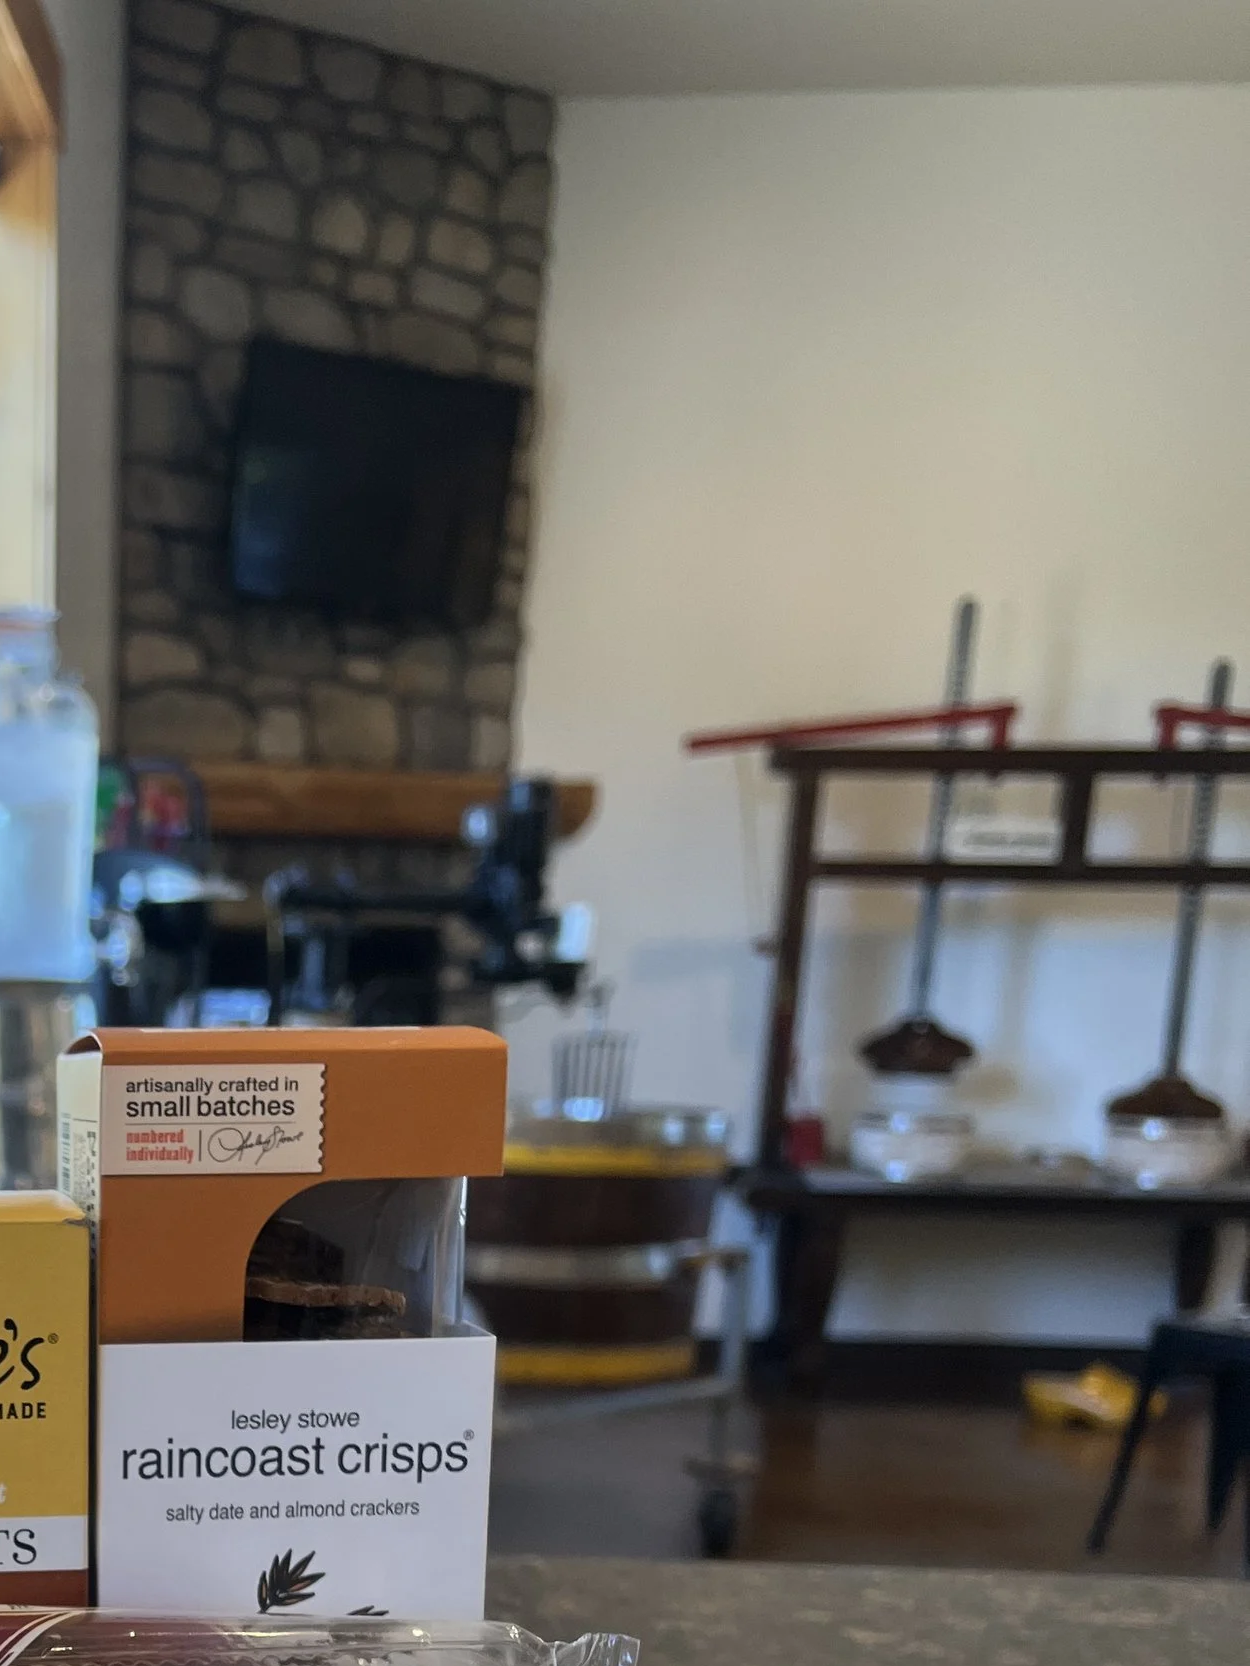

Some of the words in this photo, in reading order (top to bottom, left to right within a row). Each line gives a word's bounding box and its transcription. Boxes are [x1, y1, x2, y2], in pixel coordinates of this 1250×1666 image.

[125, 1077, 213, 1096] artisanally
[218, 1077, 279, 1093] crafted
[284, 1075, 299, 1092] in
[125, 1096, 191, 1118] small
[196, 1096, 296, 1118] batches
[125, 1128, 185, 1145] numbered
[125, 1146, 195, 1165] individually
[230, 1409, 291, 1434] lesley
[297, 1409, 361, 1428] stowe
[121, 1437, 326, 1480] raincoast
[165, 1502, 204, 1525] salty
[208, 1502, 244, 1521] date
[249, 1500, 280, 1519] and
[285, 1499, 345, 1518] almond
[350, 1497, 420, 1517] crackers
